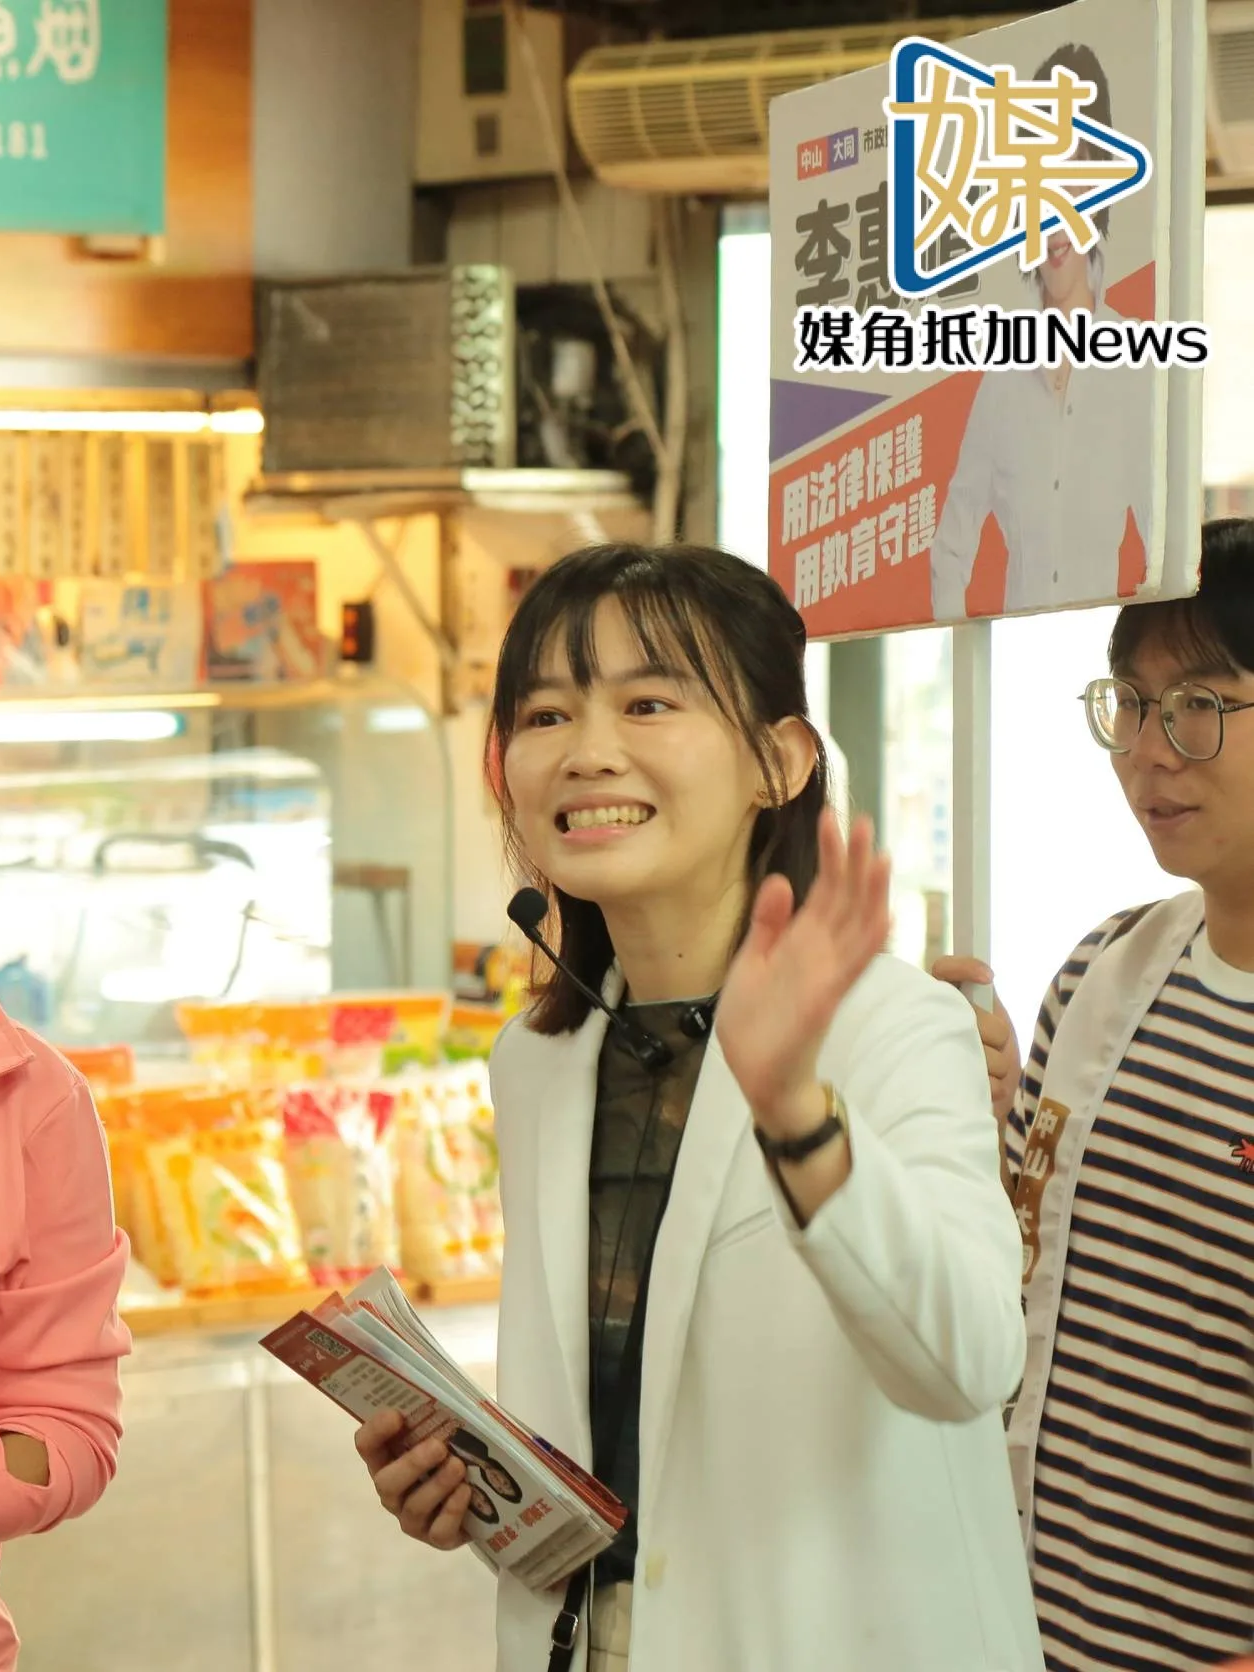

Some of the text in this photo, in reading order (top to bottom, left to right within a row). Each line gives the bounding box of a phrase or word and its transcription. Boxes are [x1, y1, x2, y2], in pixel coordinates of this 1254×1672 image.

[801, 125, 888, 172] 中山 大同 市政
[782, 414, 923, 546] 用法律保護
[794, 483, 937, 612] 用教育守護
